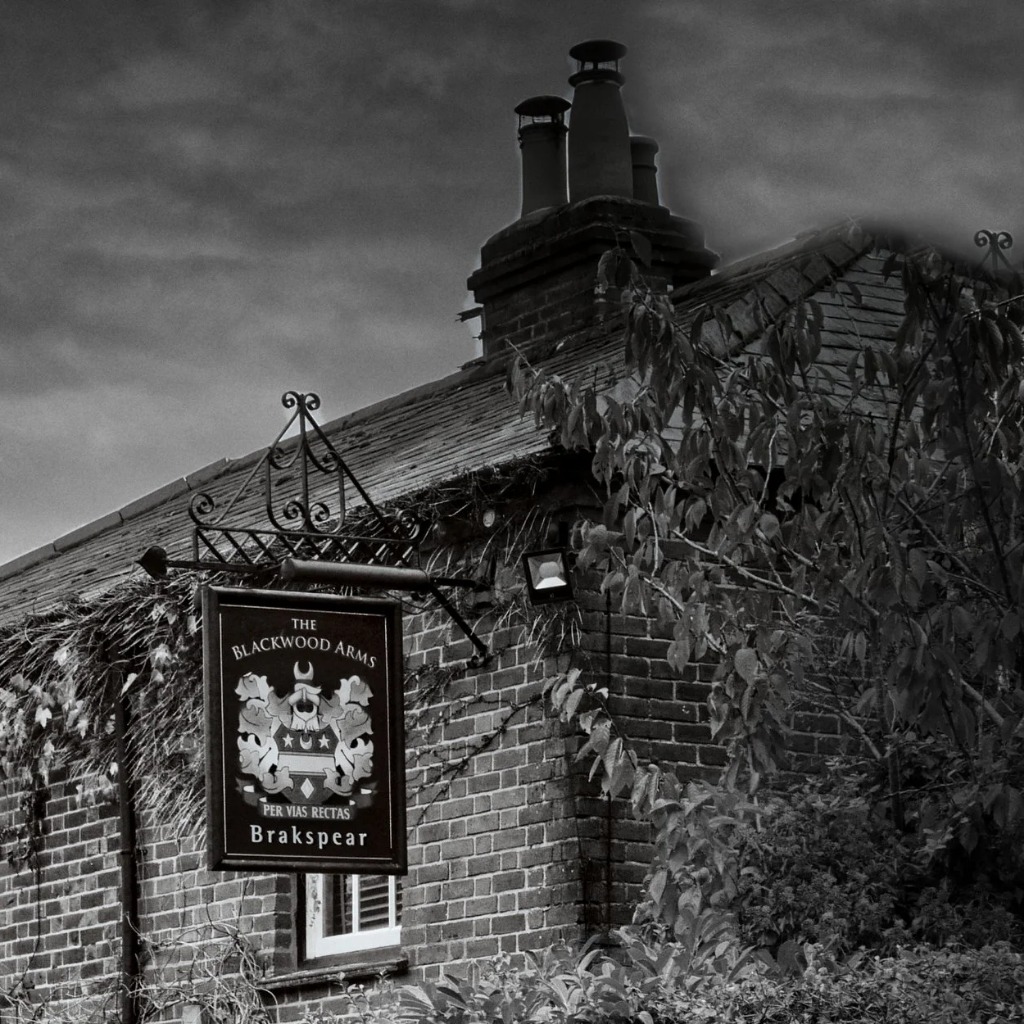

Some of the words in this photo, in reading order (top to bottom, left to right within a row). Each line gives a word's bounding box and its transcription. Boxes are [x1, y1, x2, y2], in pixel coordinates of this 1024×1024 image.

[291, 618, 317, 631] THE
[231, 636, 331, 660] BLACKWOOD
[334, 640, 377, 669] ARMS
[263, 804, 283, 817] PER
[286, 805, 308, 818] VIAS
[311, 806, 351, 820] RECTAS
[250, 824, 368, 849] Brakspear
